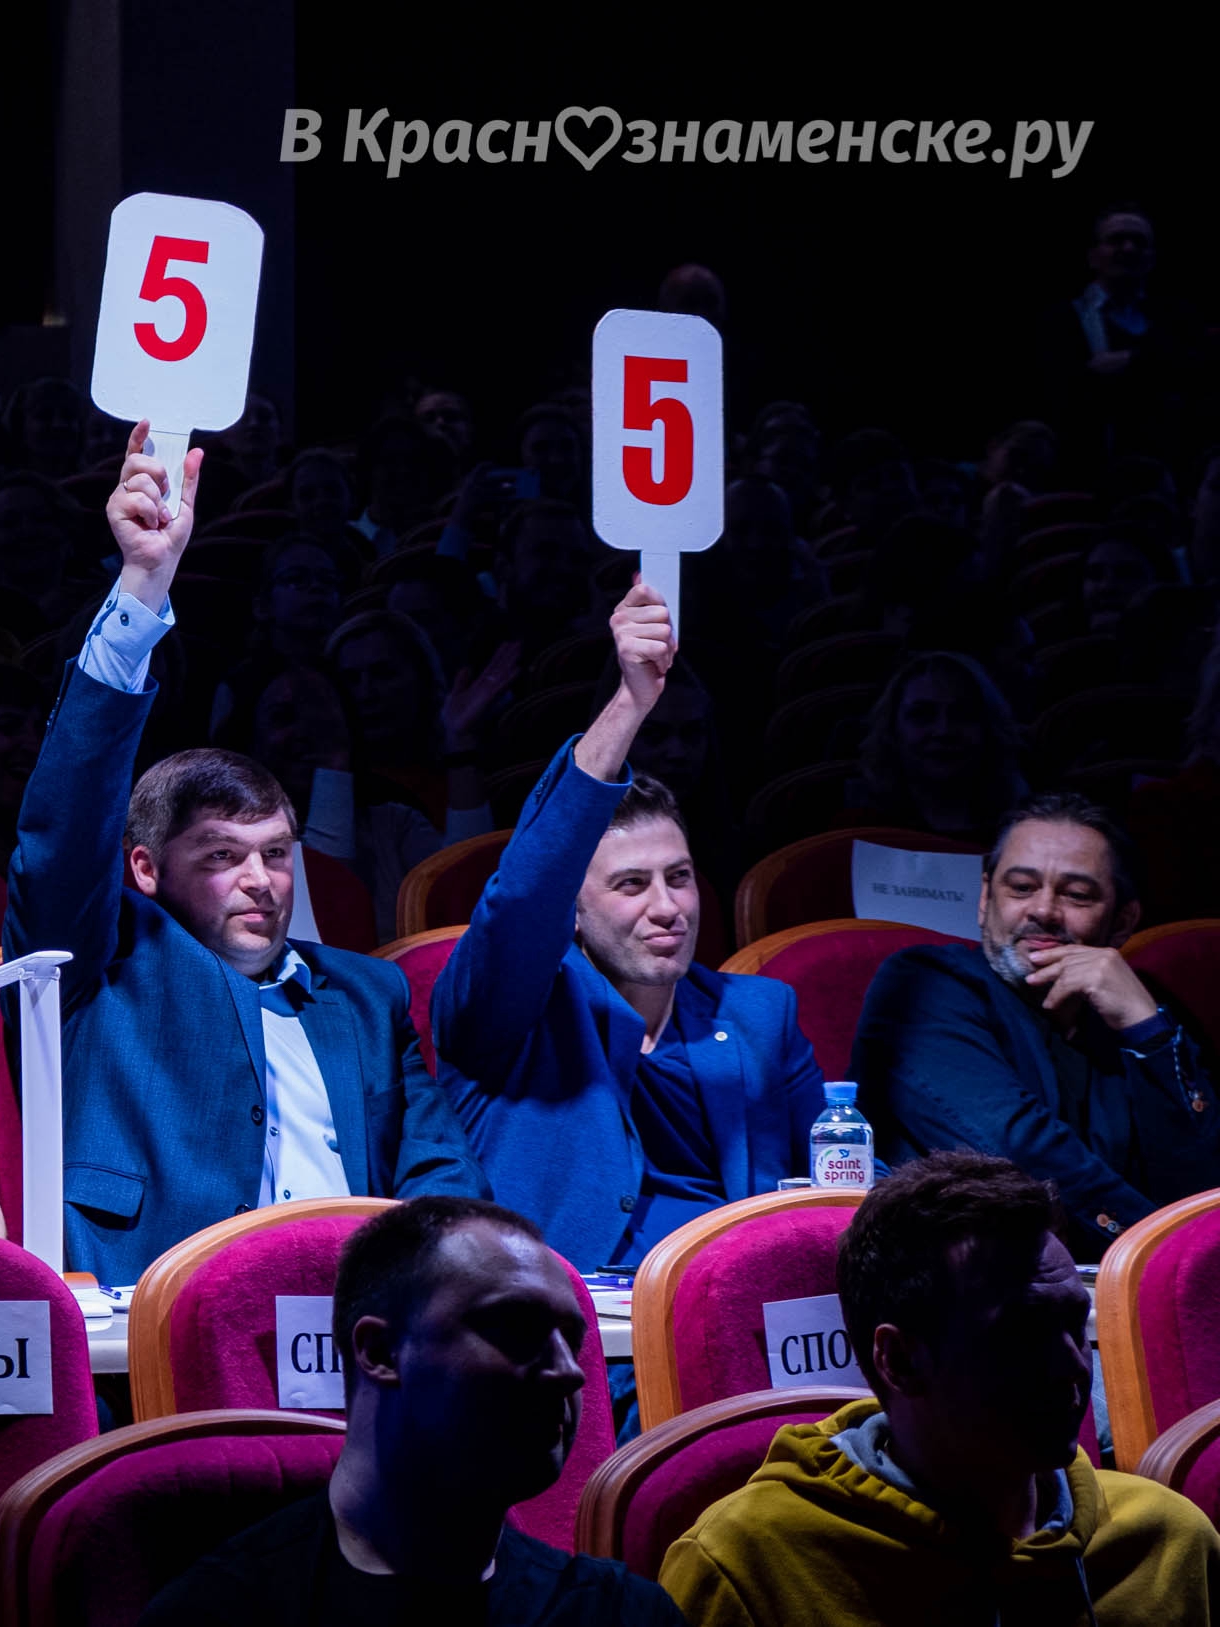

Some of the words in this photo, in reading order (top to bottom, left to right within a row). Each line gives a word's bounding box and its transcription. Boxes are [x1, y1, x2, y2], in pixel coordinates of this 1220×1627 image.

[133, 235, 209, 362] 5
[622, 355, 694, 506] 5
[824, 1171, 865, 1183] spring
[828, 1158, 861, 1169] saint
[781, 1329, 859, 1375] СПО
